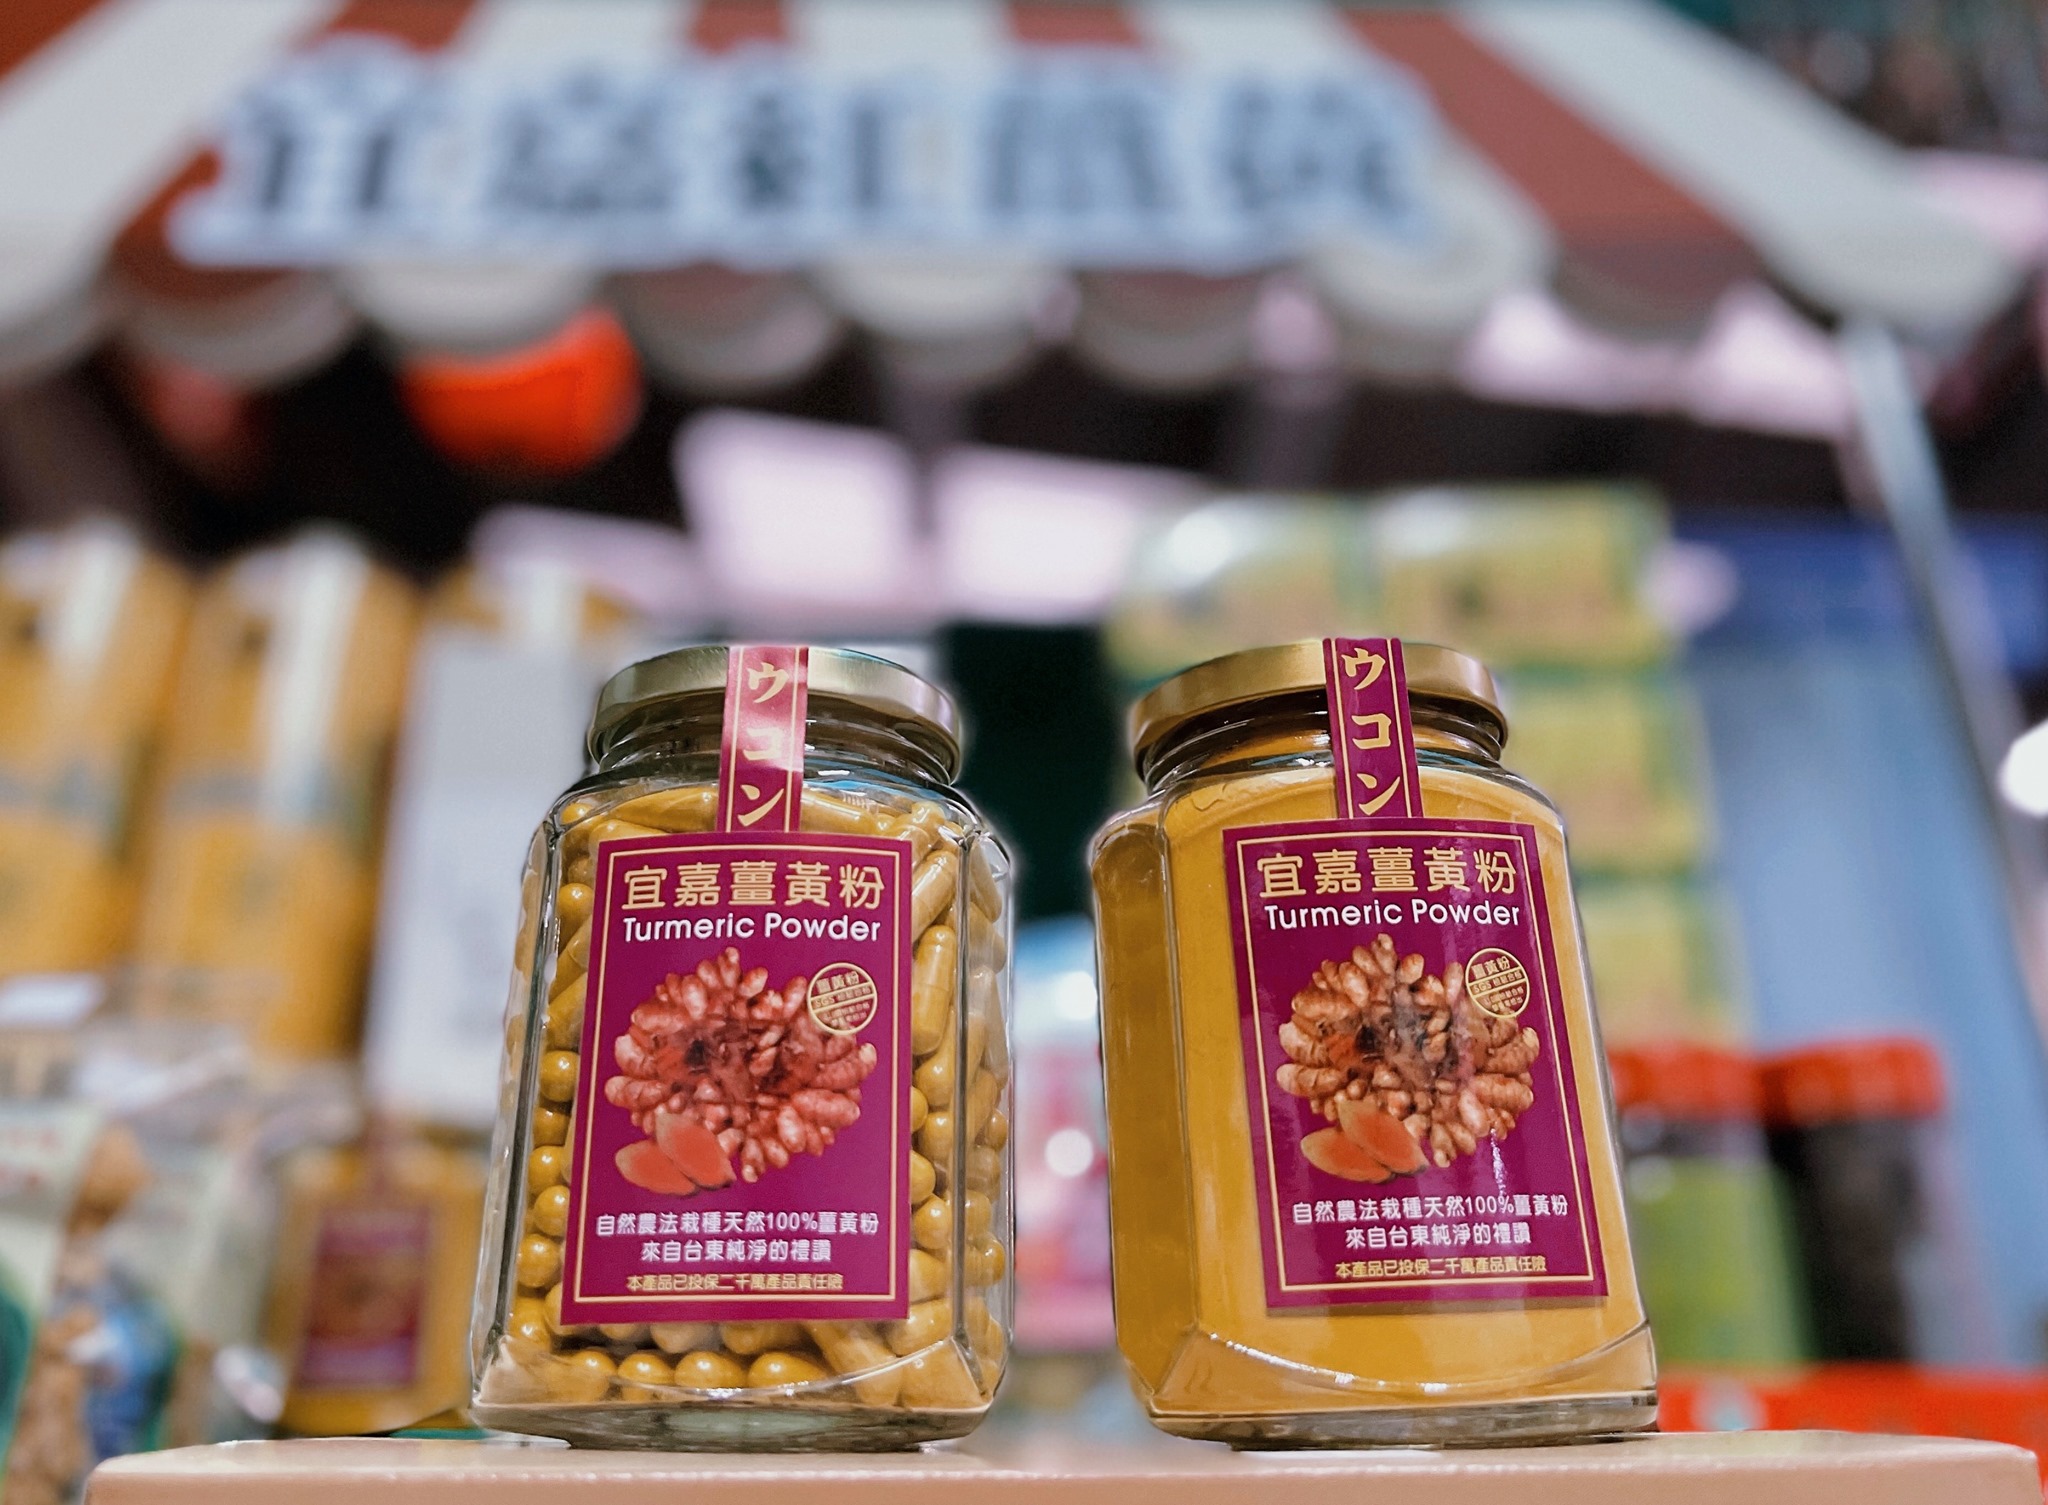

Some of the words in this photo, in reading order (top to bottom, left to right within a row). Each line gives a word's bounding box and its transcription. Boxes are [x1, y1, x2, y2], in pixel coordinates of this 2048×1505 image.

[737, 661, 789, 827] ウコン
[1341, 647, 1400, 816] ウコン
[621, 860, 884, 910] 宜嘉薑黃粉
[1257, 846, 1517, 898] 宜嘉薑黃粉
[623, 913, 755, 942] Turmeric
[764, 913, 881, 941] Powder
[1264, 899, 1403, 931] Turmeric
[1411, 899, 1520, 926] Powder
[596, 1210, 880, 1237] 自然農法栽種天然100%薑黃粉
[1292, 1194, 1569, 1225] 自然農法栽種天然100%薑黃粉
